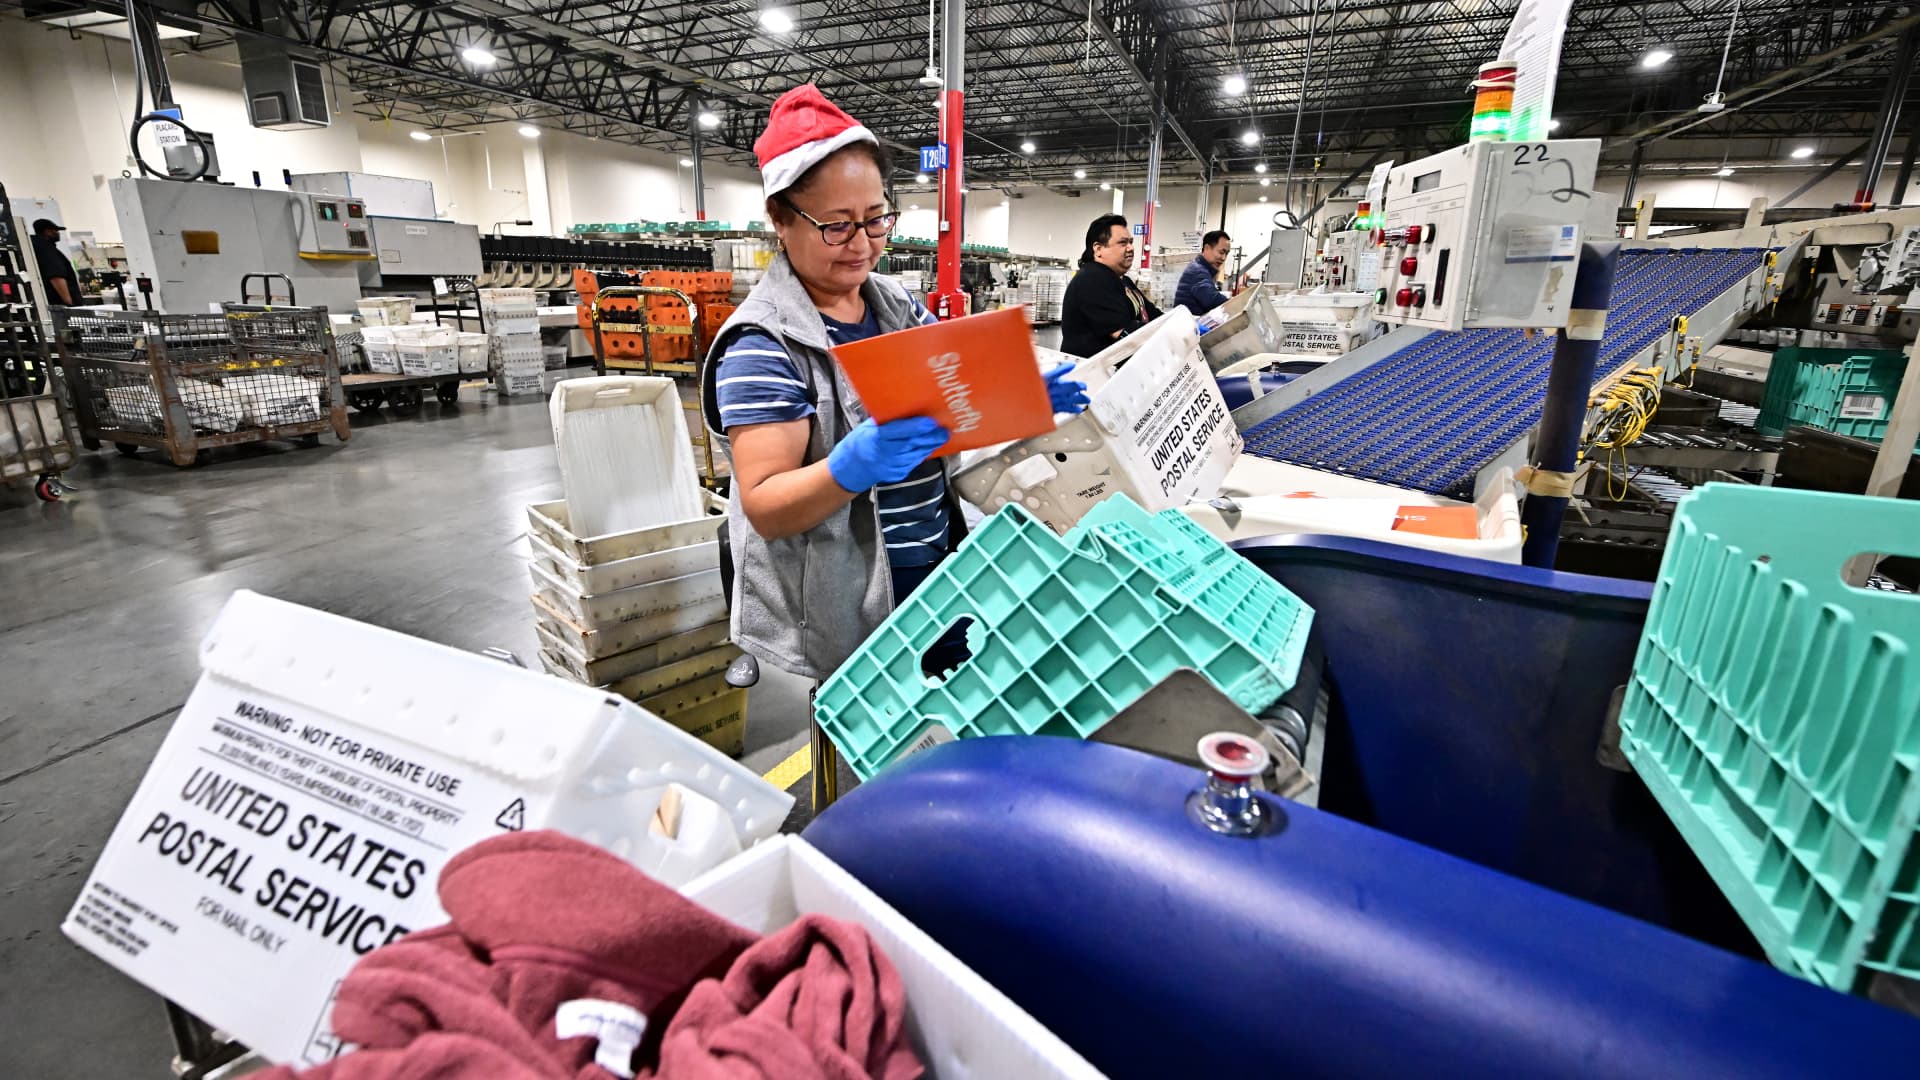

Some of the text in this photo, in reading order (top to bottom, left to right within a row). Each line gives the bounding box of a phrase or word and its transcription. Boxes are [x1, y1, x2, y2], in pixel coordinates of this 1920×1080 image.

[1514, 144, 1550, 166] 22
[1282, 341, 1341, 350] OSTAL SERVICE
[1307, 334, 1338, 342] STATES
[927, 351, 983, 433] Shutterfly
[1133, 408, 1154, 434] WARNING
[1168, 371, 1185, 392] PRIVATE
[1151, 425, 1184, 471] UNITED
[1181, 388, 1212, 432] STATES
[1160, 446, 1196, 498] POSTAL
[1192, 402, 1225, 452] SERVICE
[234, 700, 293, 733] WARNING
[299, 724, 331, 748] NOT
[328, 736, 361, 760] FOR
[360, 743, 425, 784] PRIVATE
[424, 770, 462, 797] USE
[137, 811, 254, 895] POSTAL
[181, 765, 426, 899] UNITED STATES
[196, 896, 226, 918] FOR
[222, 908, 250, 938] MAIL
[249, 923, 288, 955] ONLY
